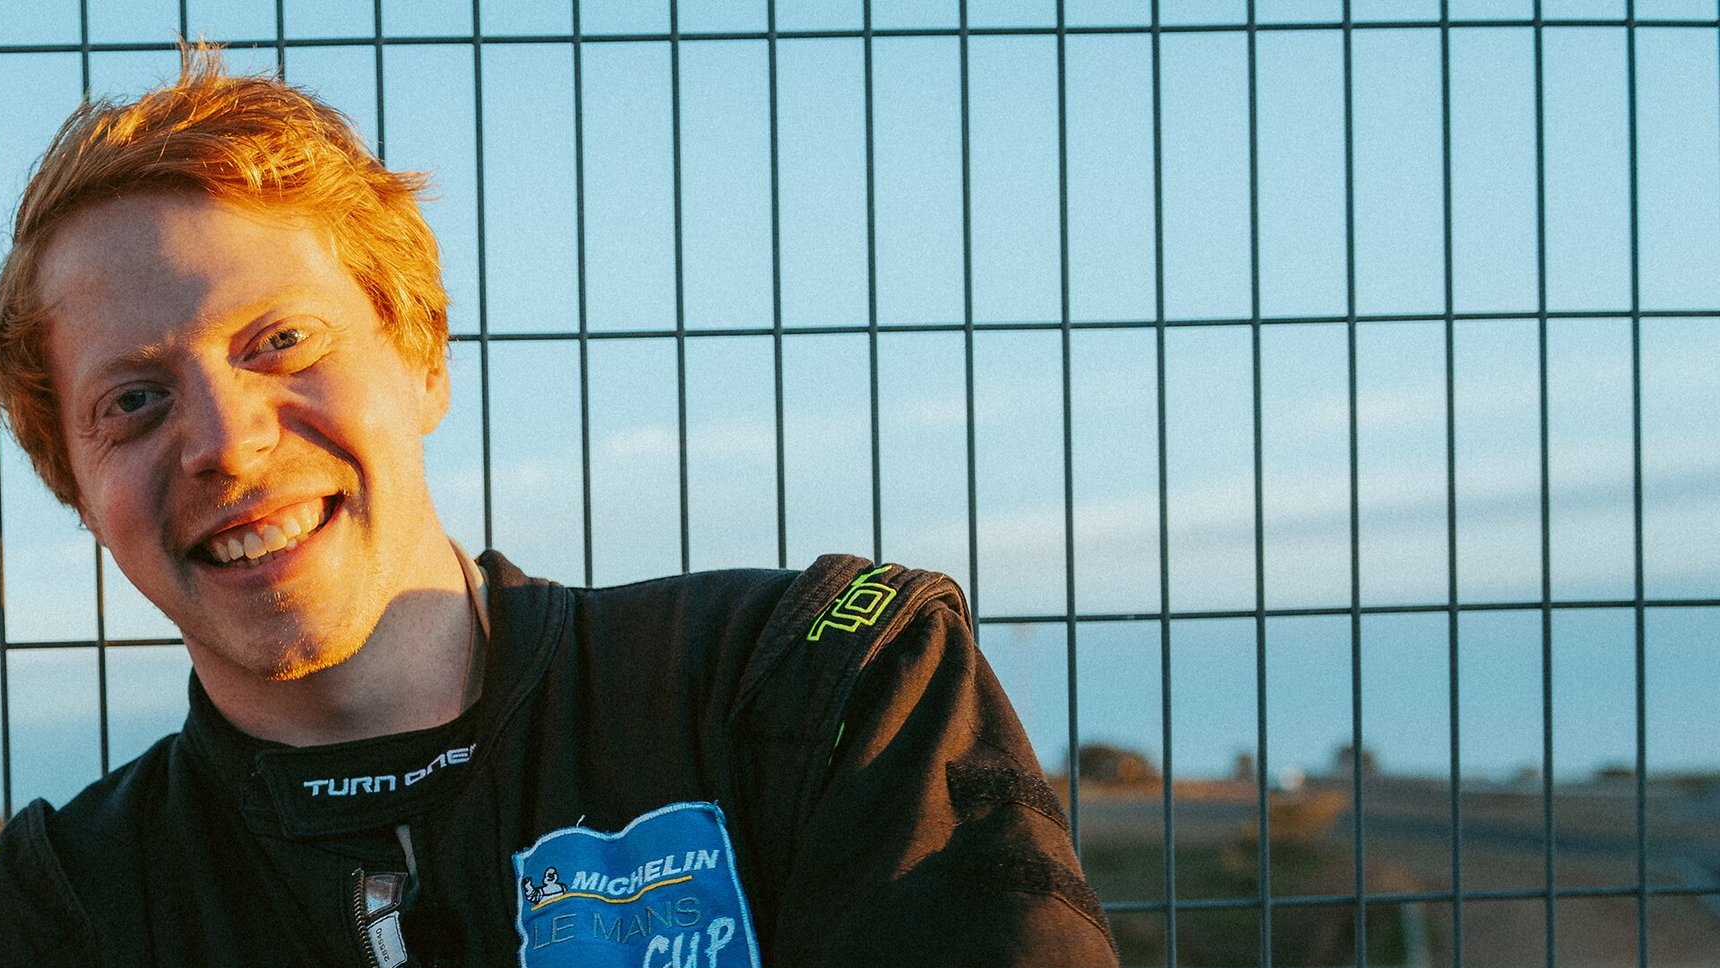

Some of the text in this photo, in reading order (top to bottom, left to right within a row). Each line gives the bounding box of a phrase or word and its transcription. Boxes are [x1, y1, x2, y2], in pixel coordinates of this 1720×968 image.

[303, 747, 471, 796] TURN ONE
[571, 850, 720, 896] MICHELIN
[532, 896, 701, 951] LE MANS
